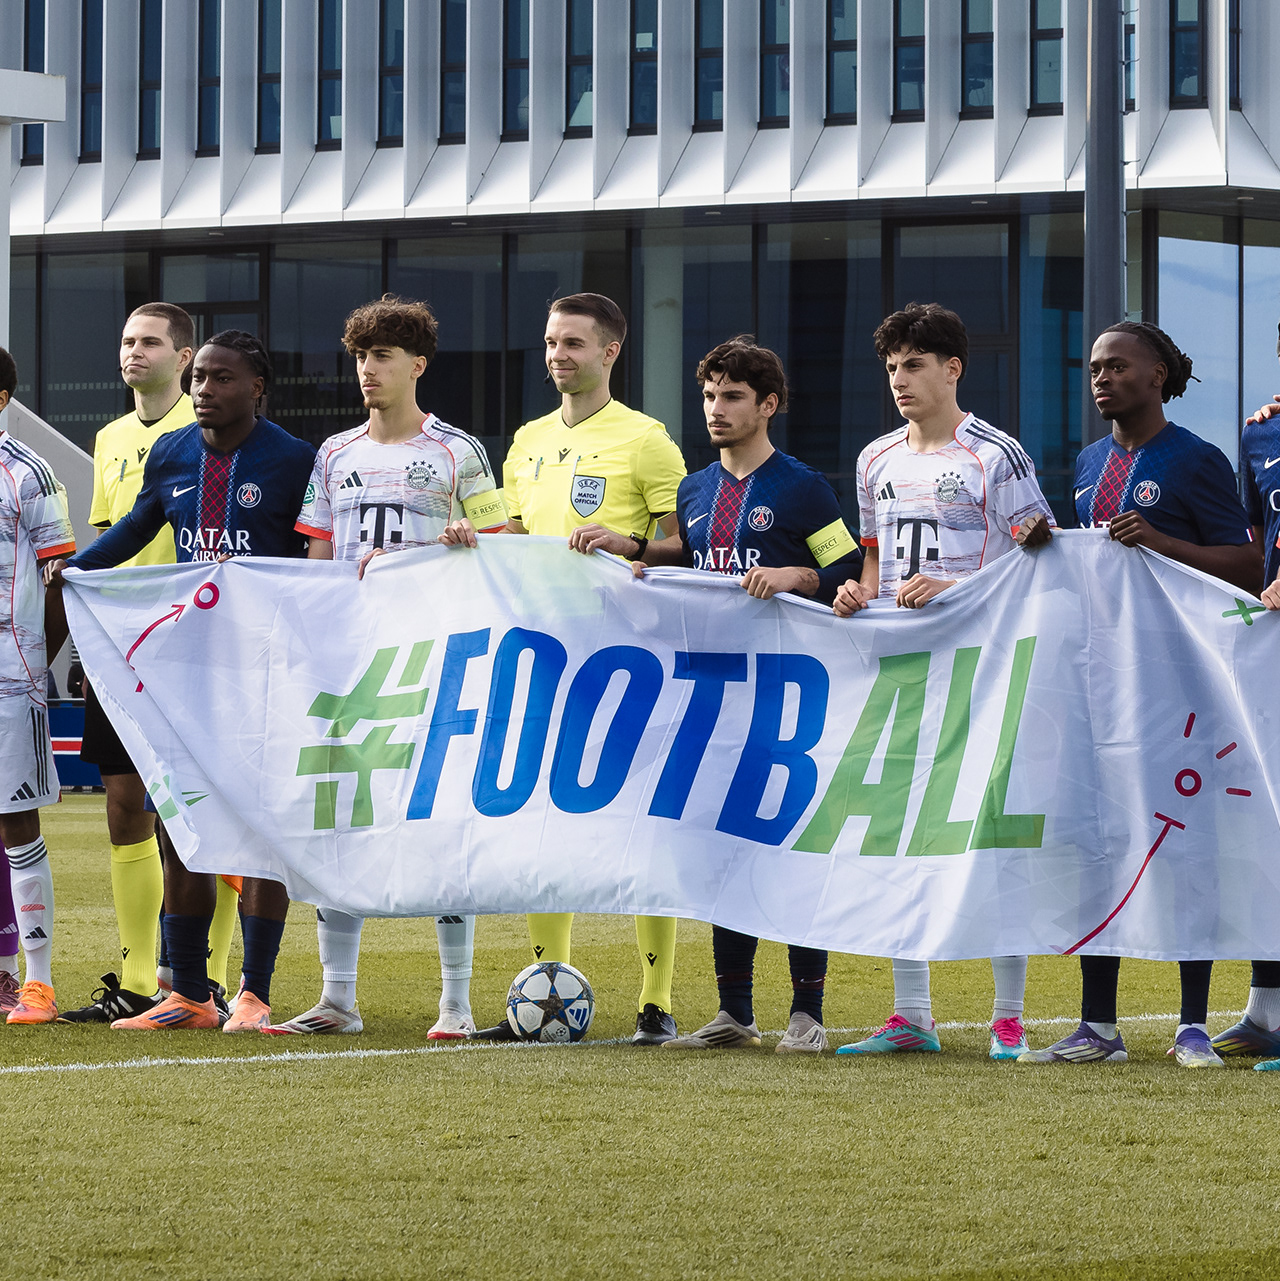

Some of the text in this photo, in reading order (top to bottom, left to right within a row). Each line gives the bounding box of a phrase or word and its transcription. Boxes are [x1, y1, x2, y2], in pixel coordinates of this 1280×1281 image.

[577, 479, 600, 491] UEFA
[577, 492, 598, 500] MATCH
[574, 498, 598, 507] OFFICIAL
[179, 527, 252, 553] QATAR
[295, 626, 1046, 857] #FOOTBALL
